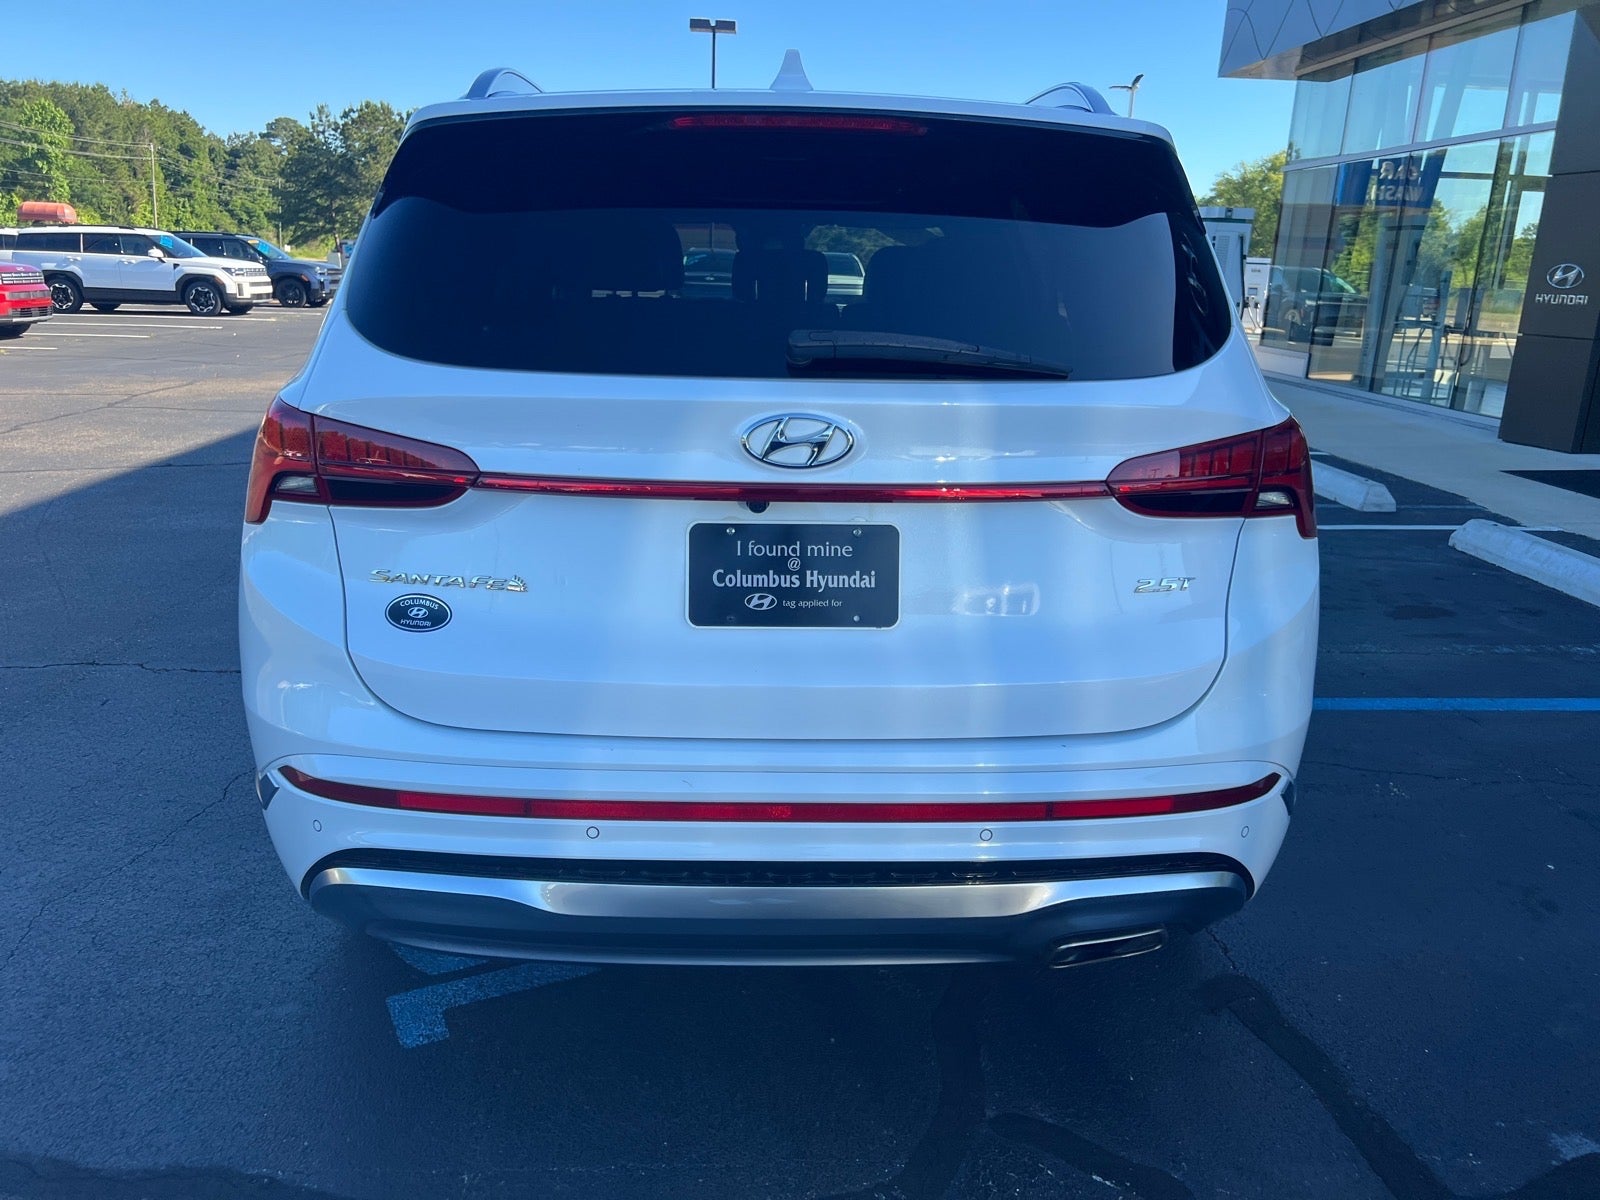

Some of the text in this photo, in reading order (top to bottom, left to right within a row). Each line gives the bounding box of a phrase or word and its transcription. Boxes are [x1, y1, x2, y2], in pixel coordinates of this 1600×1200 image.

[1535, 293, 1589, 305] HYUNDAI
[737, 540, 853, 557] I found mine
[787, 558, 801, 571] @
[712, 569, 876, 592] Columbus Hyundai
[400, 599, 439, 610] COLUMBUS
[782, 598, 843, 609] tag applied for
[400, 618, 432, 627] HYUNDAI
